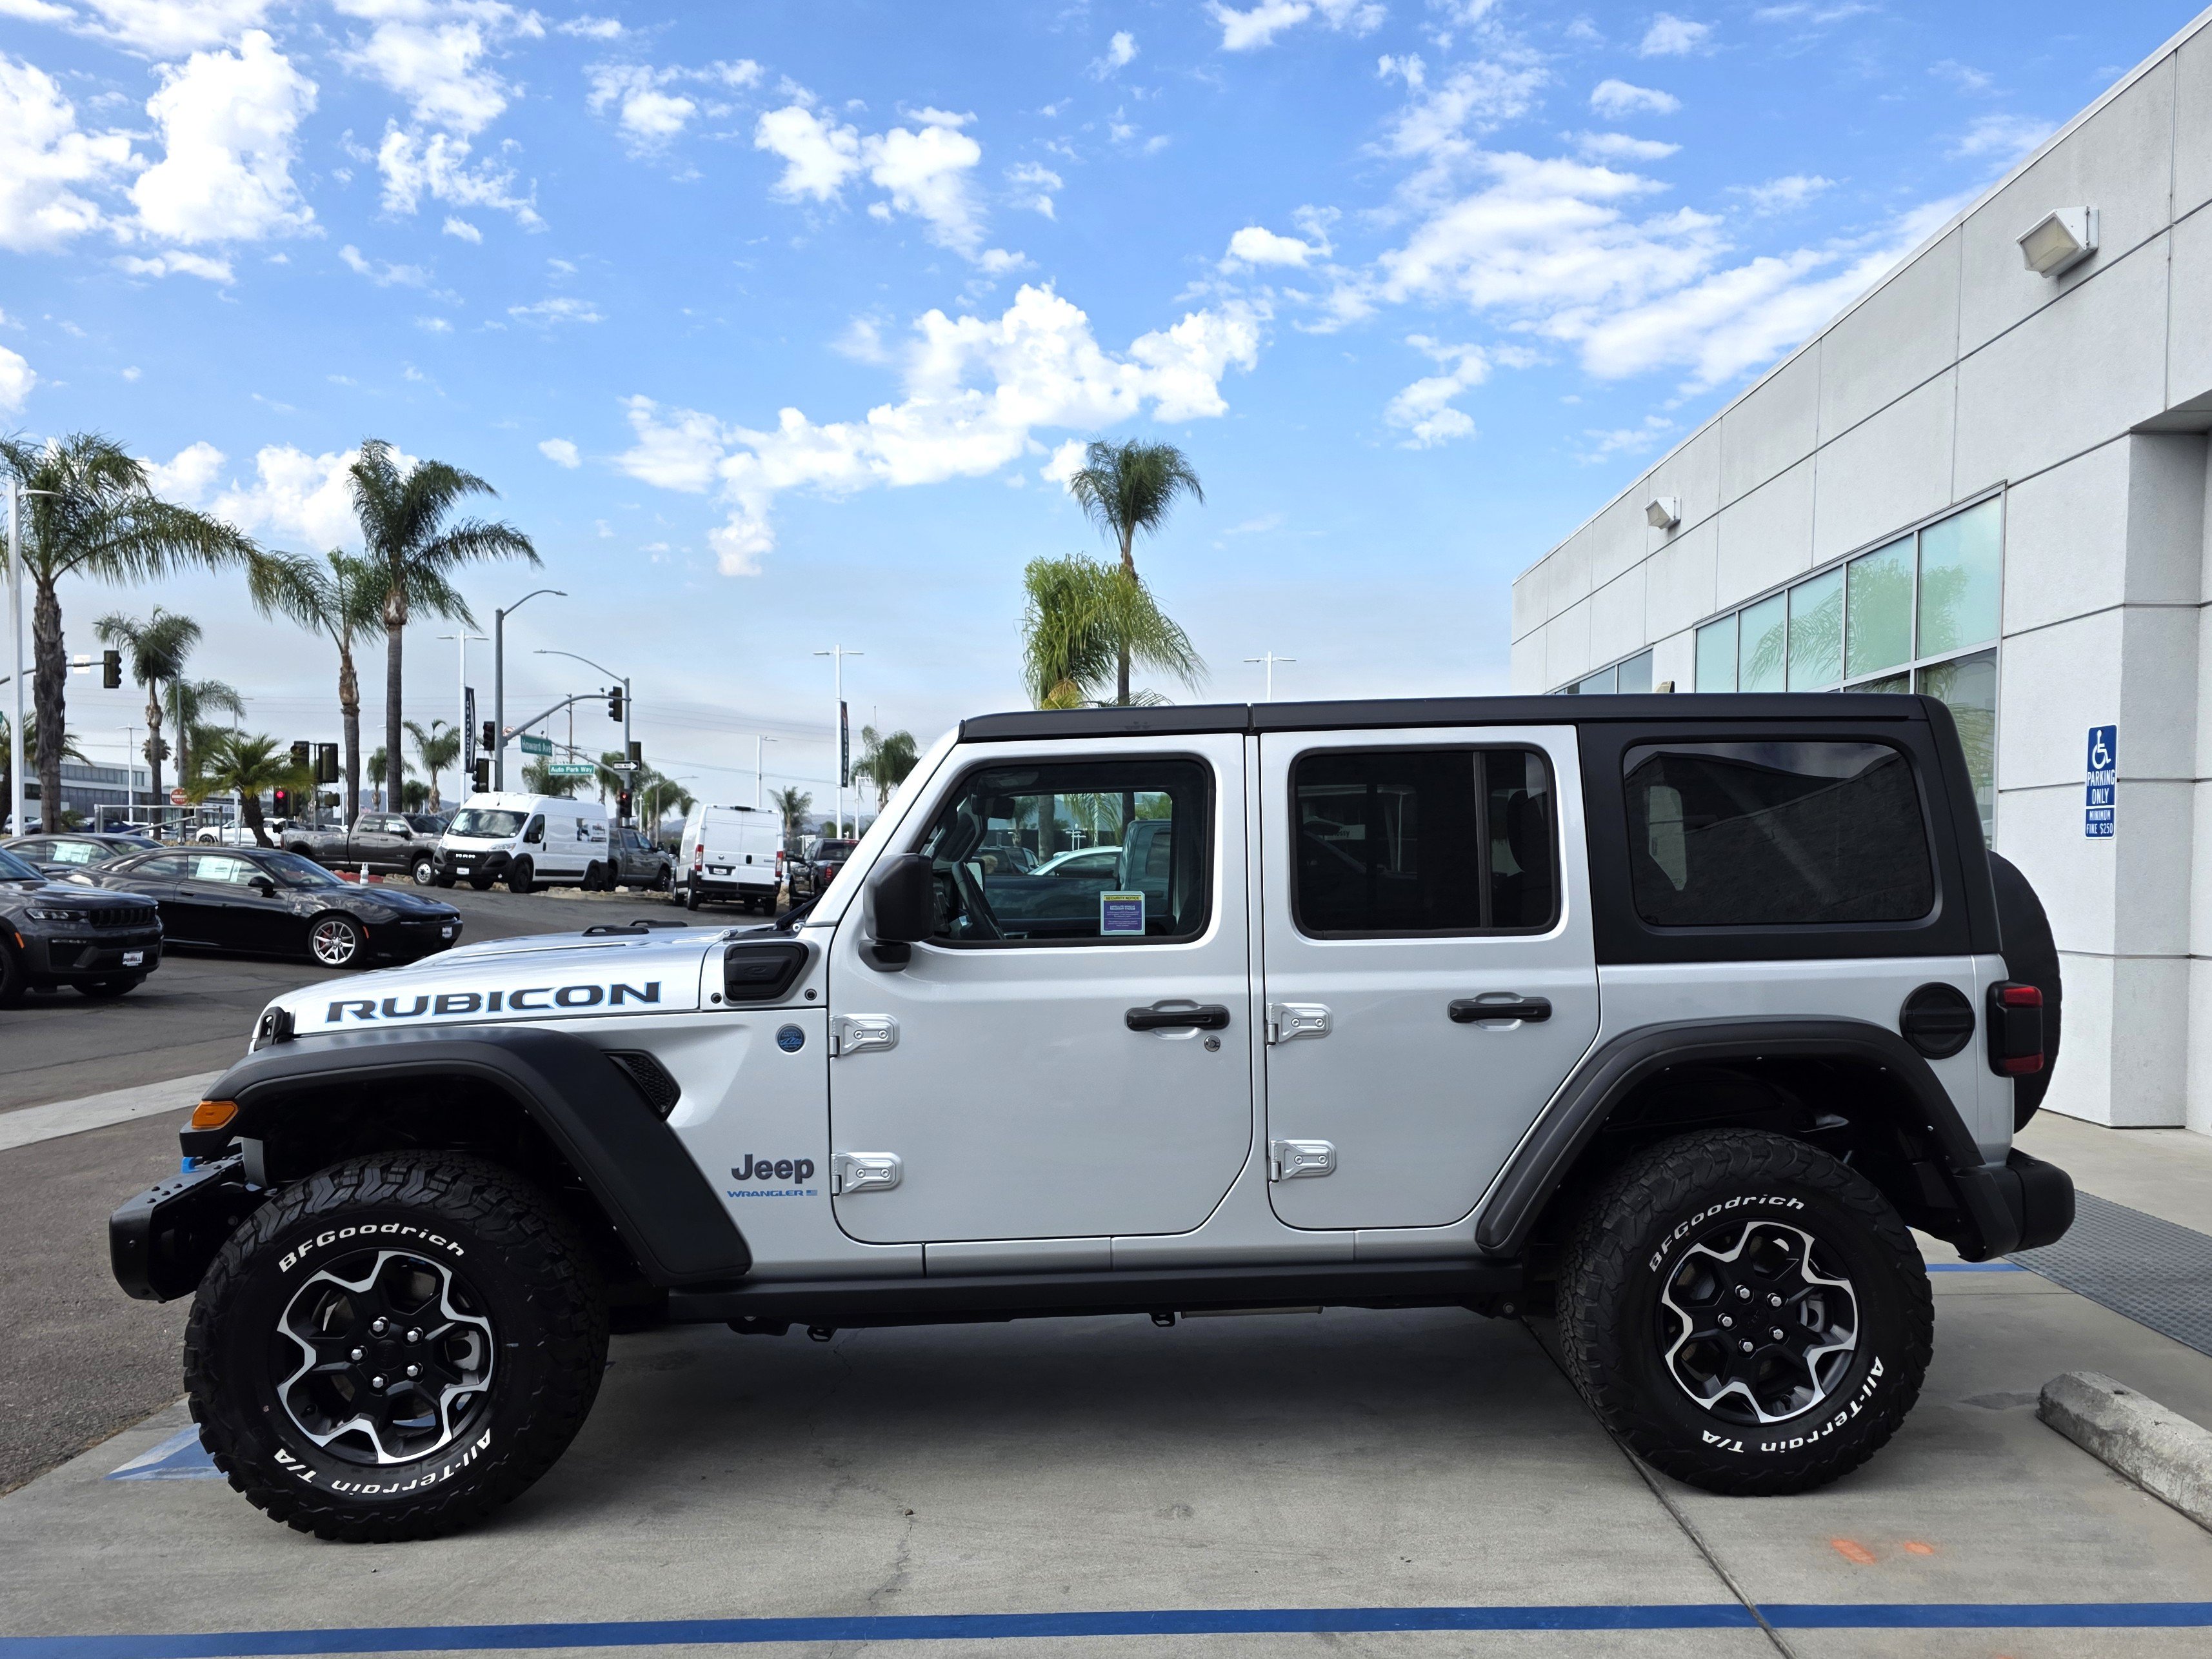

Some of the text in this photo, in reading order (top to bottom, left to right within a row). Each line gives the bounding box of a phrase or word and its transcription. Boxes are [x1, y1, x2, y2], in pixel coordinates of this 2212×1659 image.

[521, 739, 552, 753] Howard Ave
[2087, 769, 2115, 786] PARKING
[2092, 788, 2109, 804] ONLY
[2089, 810, 2111, 820] MINIMUM
[2086, 822, 2113, 835] FINE $250
[324, 981, 662, 1023] RUBICON
[731, 1153, 815, 1184] Jeep
[726, 1189, 804, 1198] WRANGLER
[1649, 1194, 1805, 1272] BFGoodrich
[279, 1223, 464, 1273] BFGoodrich
[1701, 1356, 1884, 1453] All-Terrain T/A
[274, 1428, 492, 1495] All-Terrain T/A
